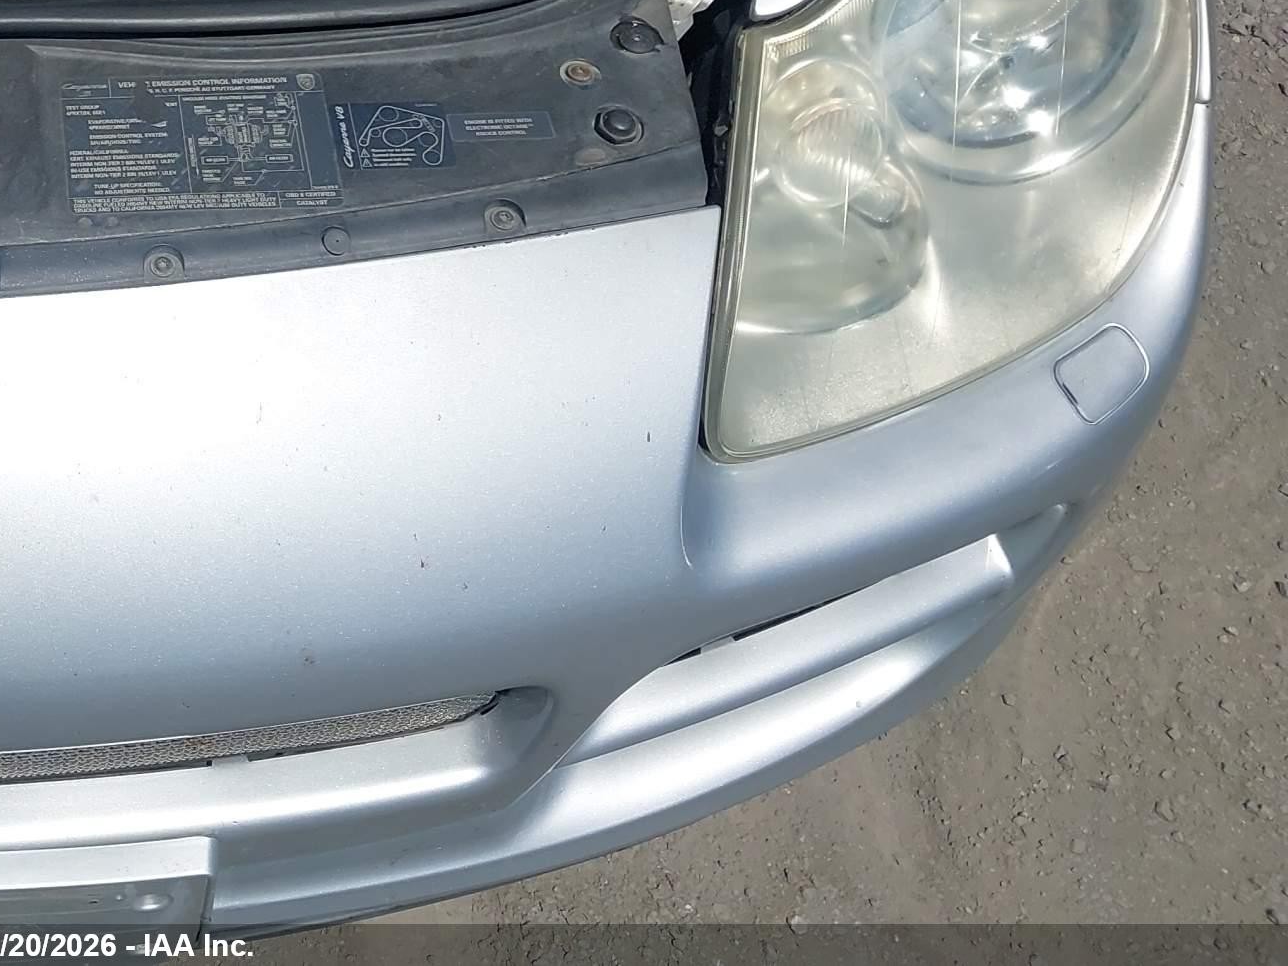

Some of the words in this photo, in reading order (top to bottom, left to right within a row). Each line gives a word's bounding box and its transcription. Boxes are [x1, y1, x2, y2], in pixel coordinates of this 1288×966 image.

[192, 78, 230, 86] CONTROL
[231, 77, 287, 85] INFORMATION
[335, 106, 345, 119] V8
[339, 122, 355, 168] Cayenne
